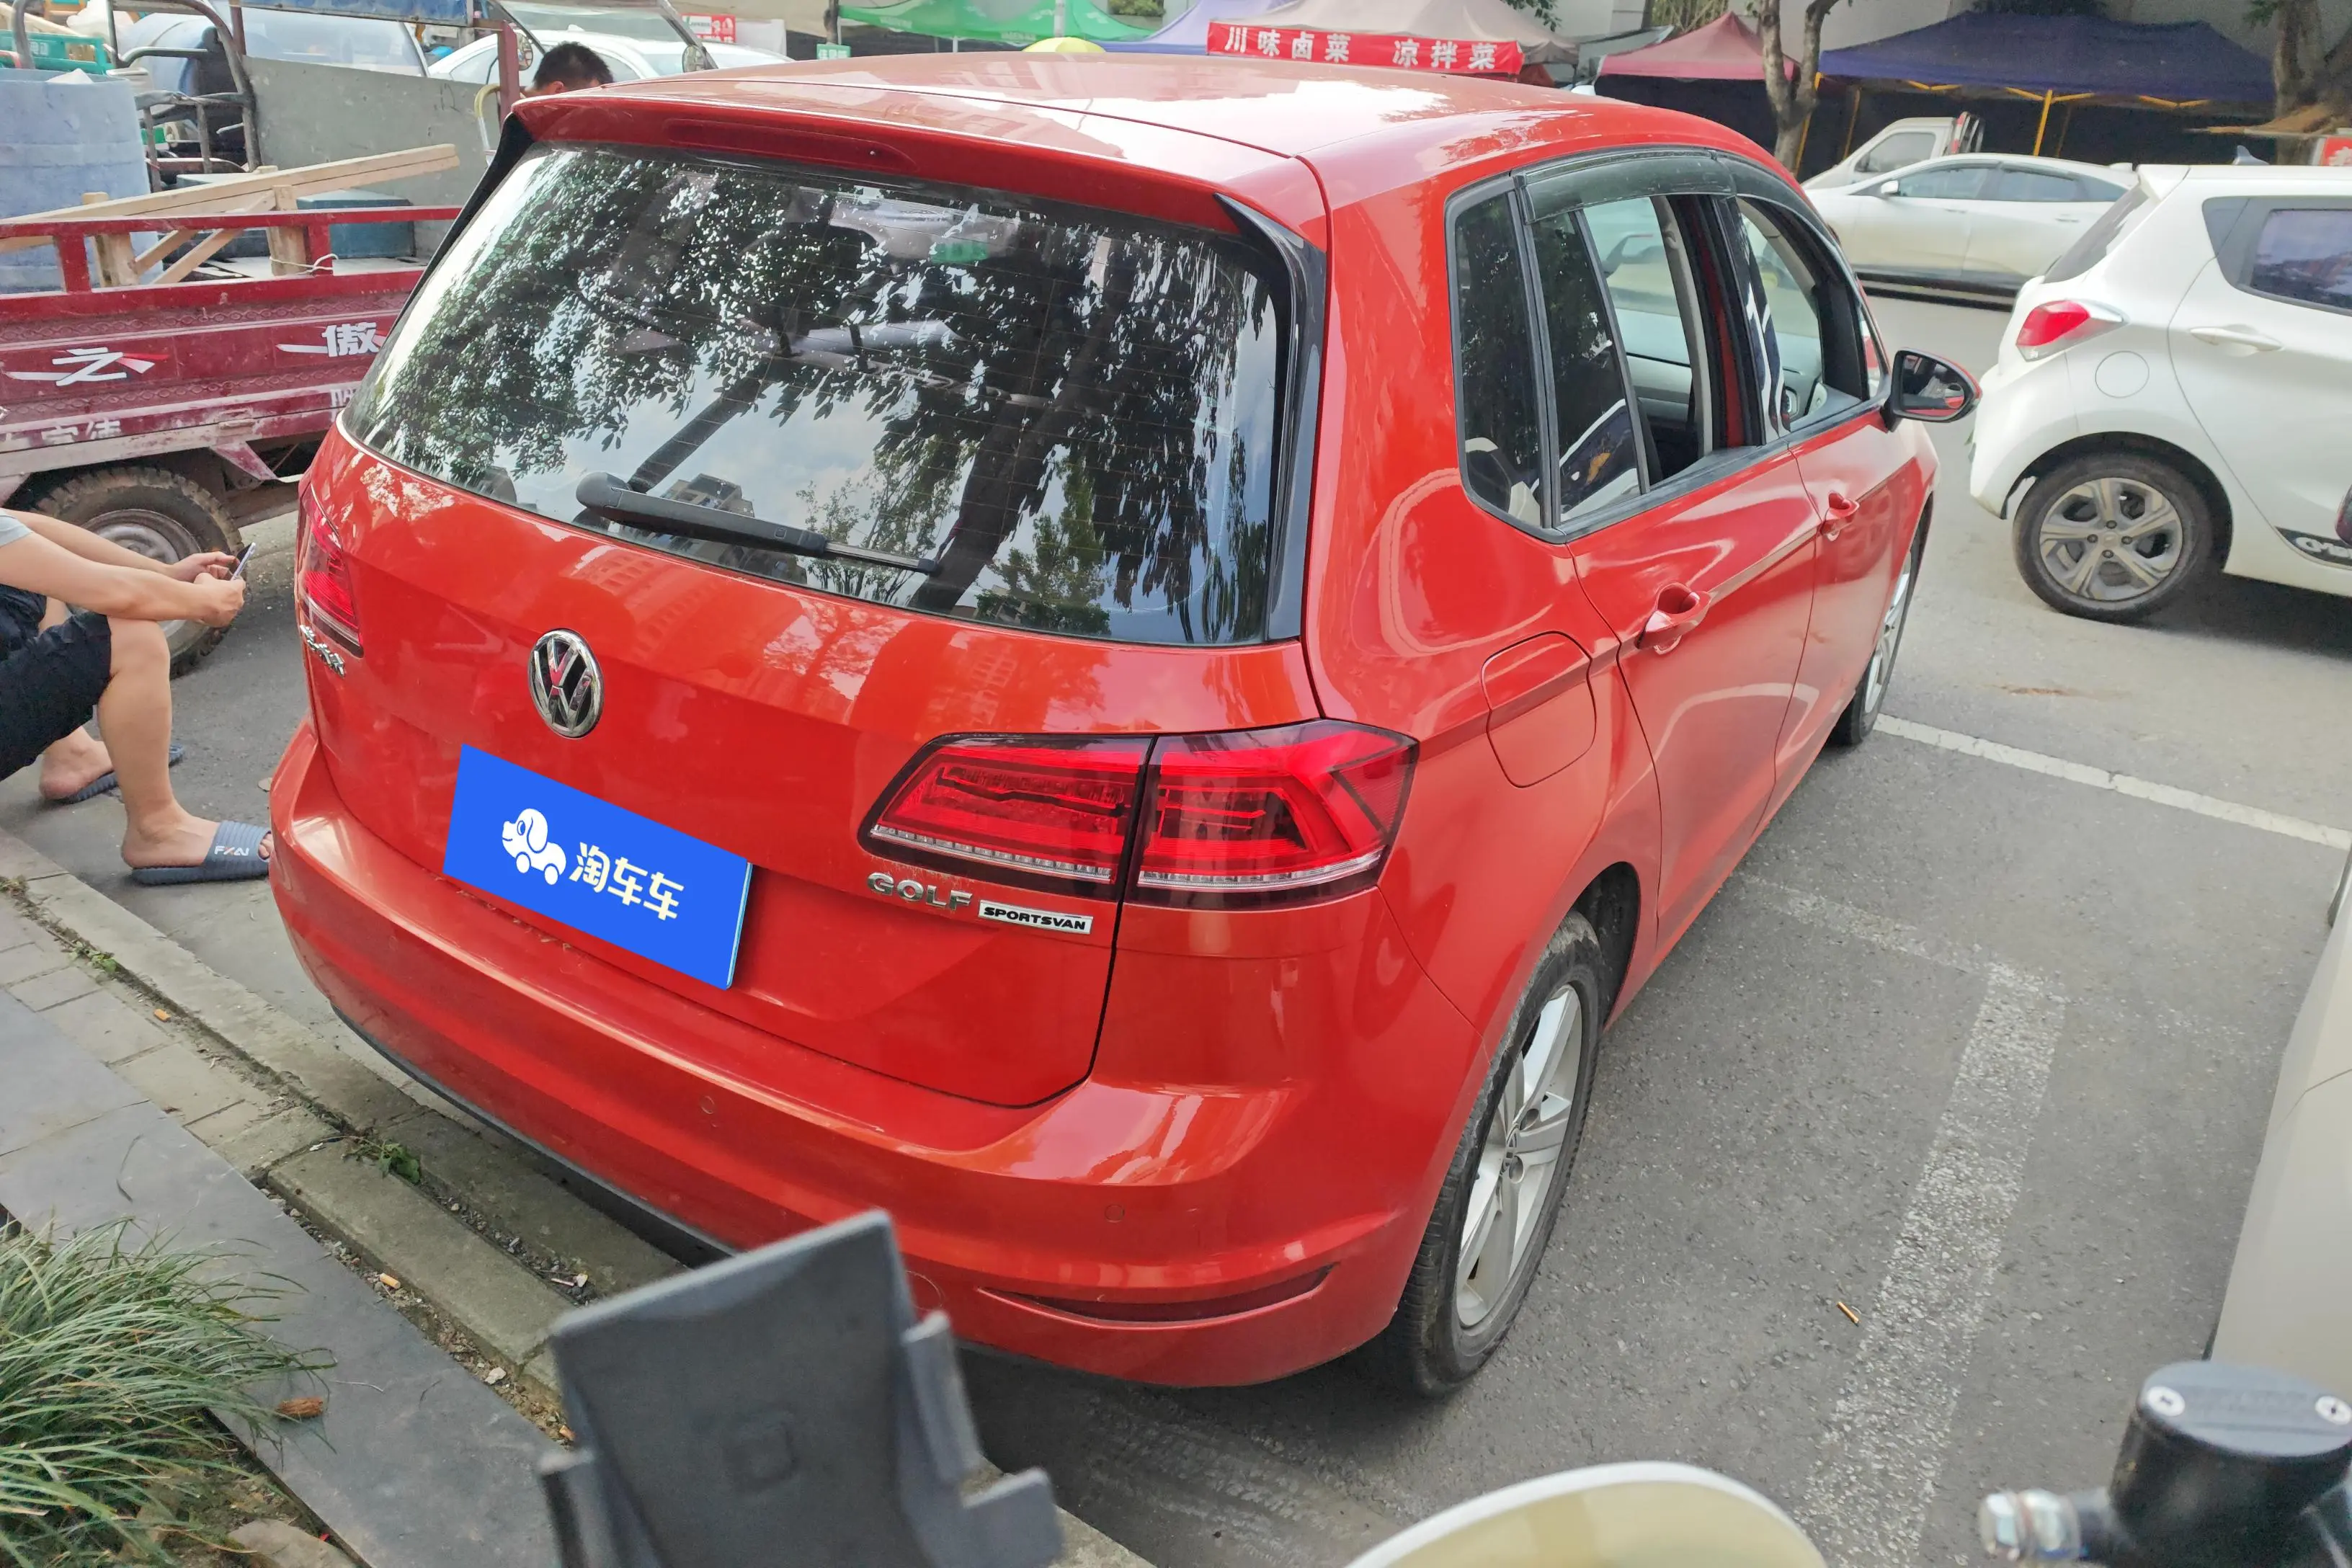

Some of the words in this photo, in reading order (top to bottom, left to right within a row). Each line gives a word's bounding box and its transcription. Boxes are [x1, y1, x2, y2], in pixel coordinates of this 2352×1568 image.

[1224, 26, 1351, 63] 川味卤菜
[1392, 38, 1498, 71] 凉拌菜
[52, 347, 128, 387] 之
[321, 322, 379, 357] 傲
[867, 872, 973, 911] GOLF
[984, 906, 1086, 930] SPORTSVAN
